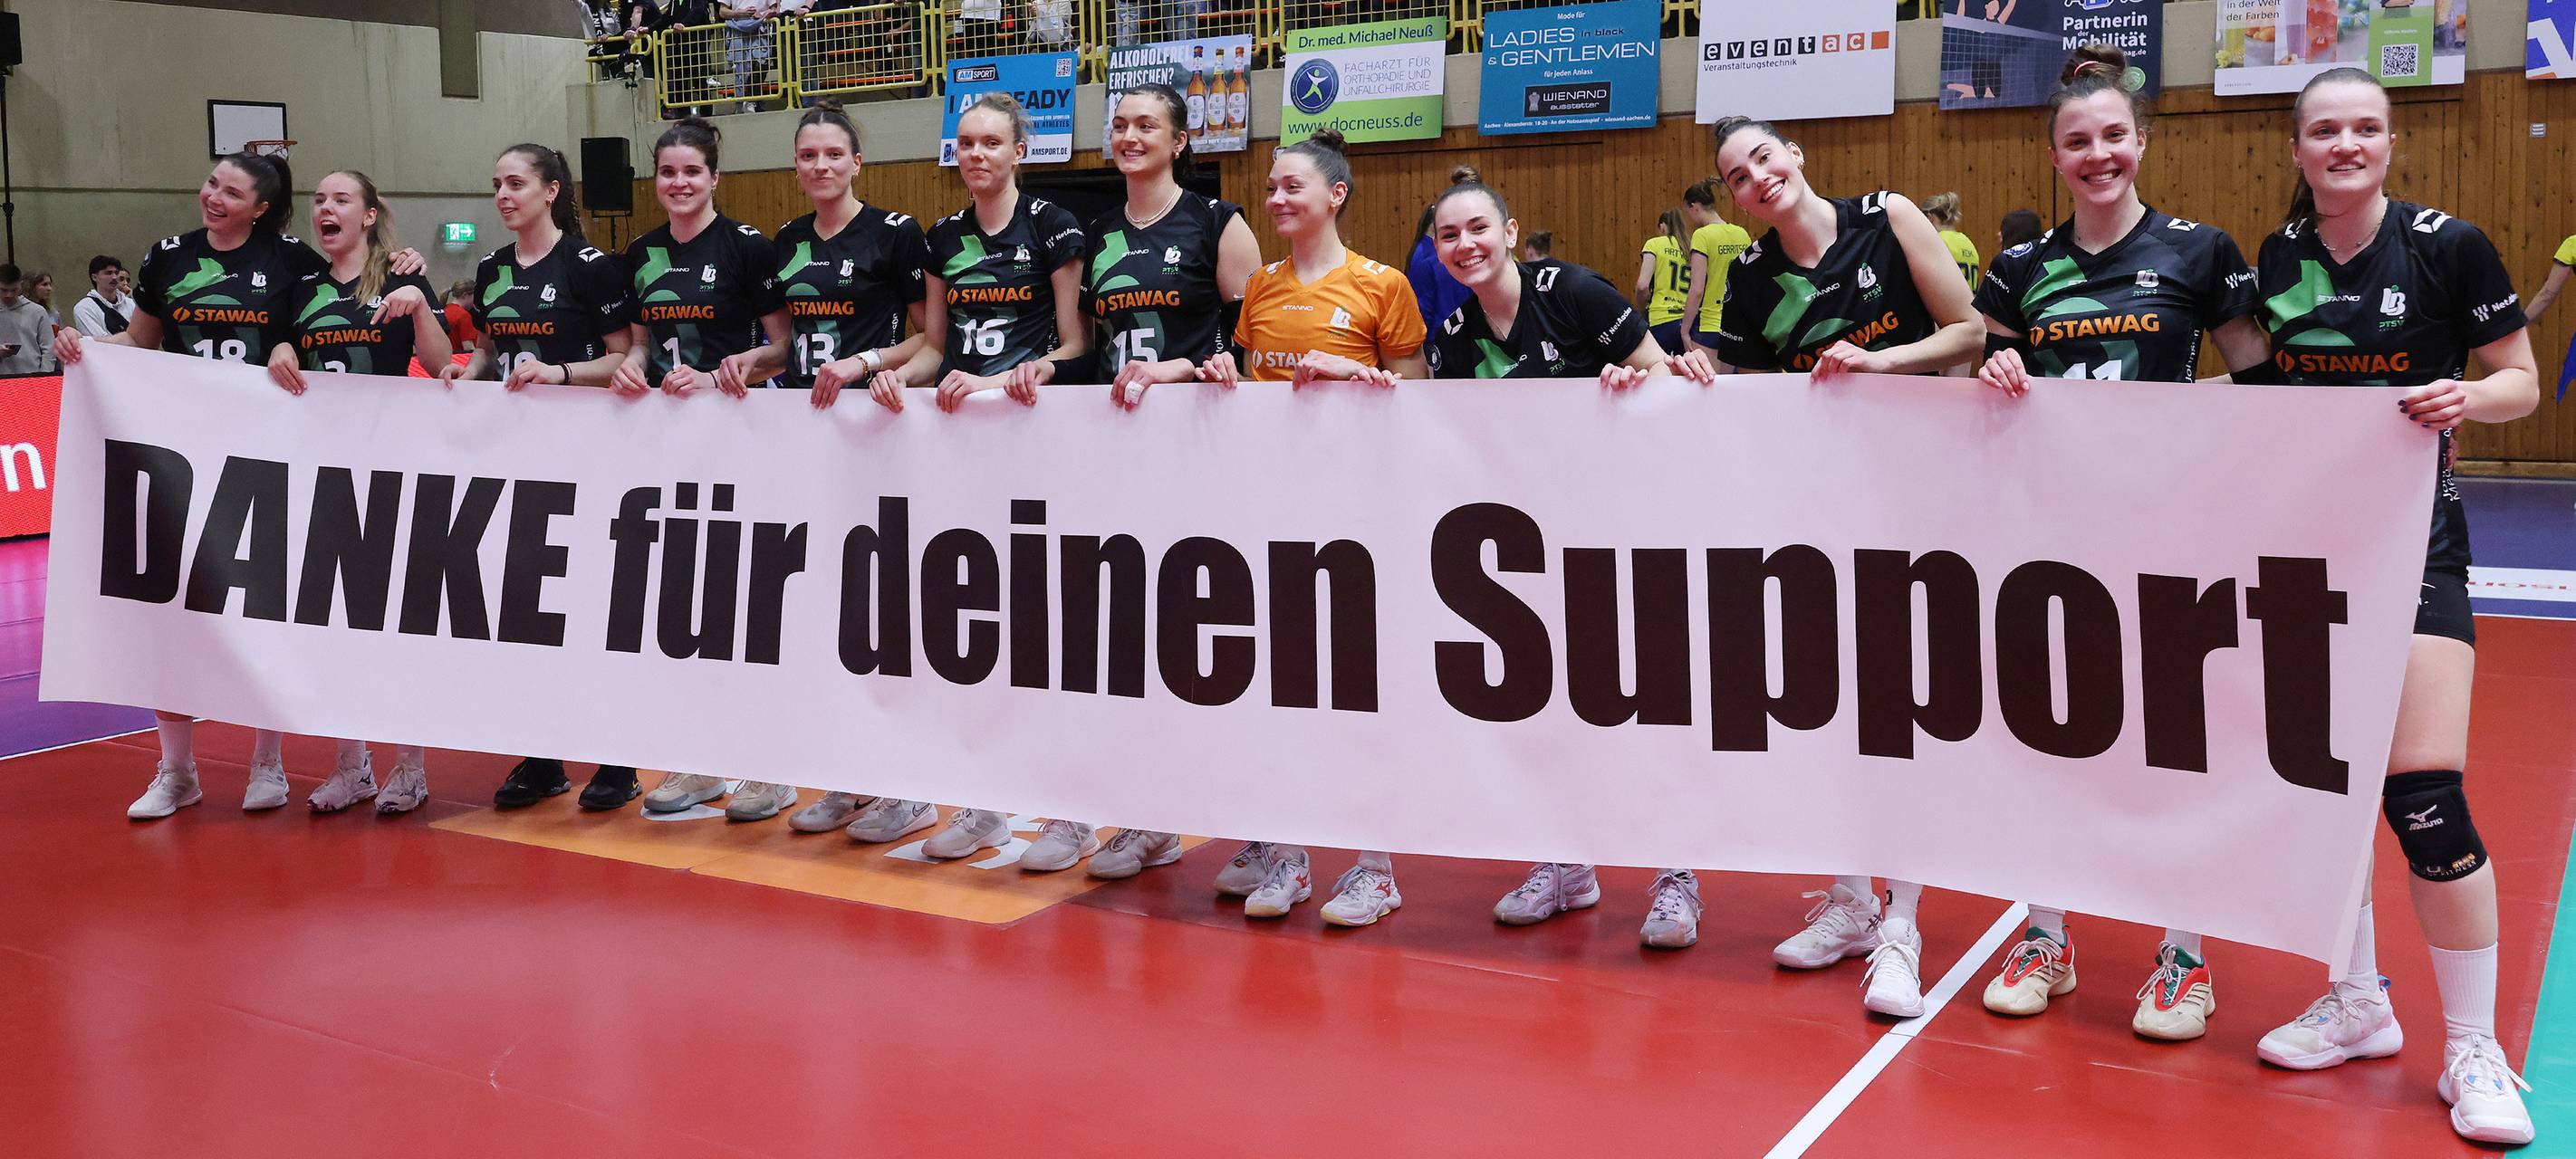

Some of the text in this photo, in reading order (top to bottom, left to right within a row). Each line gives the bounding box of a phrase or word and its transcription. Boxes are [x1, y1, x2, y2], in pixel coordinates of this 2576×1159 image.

[2238, 0, 2254, 8] der
[1575, 11, 1586, 19] für
[2062, 12, 2148, 31] Partnerin
[2226, 11, 2280, 21] der Farben
[1299, 24, 1433, 48] Dr. med. Michael Neuß
[1490, 27, 1575, 48] LADIES
[1595, 28, 1624, 37] black
[1487, 42, 1656, 67] & GENTLEMEN
[1344, 59, 1403, 73] FACHARZT
[1704, 58, 1797, 72] Veranstaltungstechnik
[1109, 68, 1175, 90] ERFRISCHEN?
[1408, 69, 1432, 80] UND
[1553, 70, 1572, 79] jeden
[1343, 81, 1431, 96] UNFALLCHIRURGIE
[1543, 90, 1607, 101] WIENAND
[1031, 148, 1068, 156] AMSPORT.DE
[961, 285, 1033, 303] STAWAG
[1107, 290, 1180, 311] STAWAG
[1804, 283, 1841, 303] STANNO
[2316, 294, 2362, 302] STANNO
[194, 309, 269, 324] STAWAG
[651, 304, 715, 321] STAWAG
[793, 301, 855, 316] STAWAG
[492, 321, 555, 335] STAWAG
[2049, 313, 2160, 341] STAWAG
[315, 329, 383, 346] STAWAG
[955, 318, 1005, 356] 16
[796, 332, 836, 376] 13
[1112, 327, 1159, 375] 15
[2299, 352, 2410, 373] STAWAG
[101, 438, 2349, 795] DANKE für deinen Support
